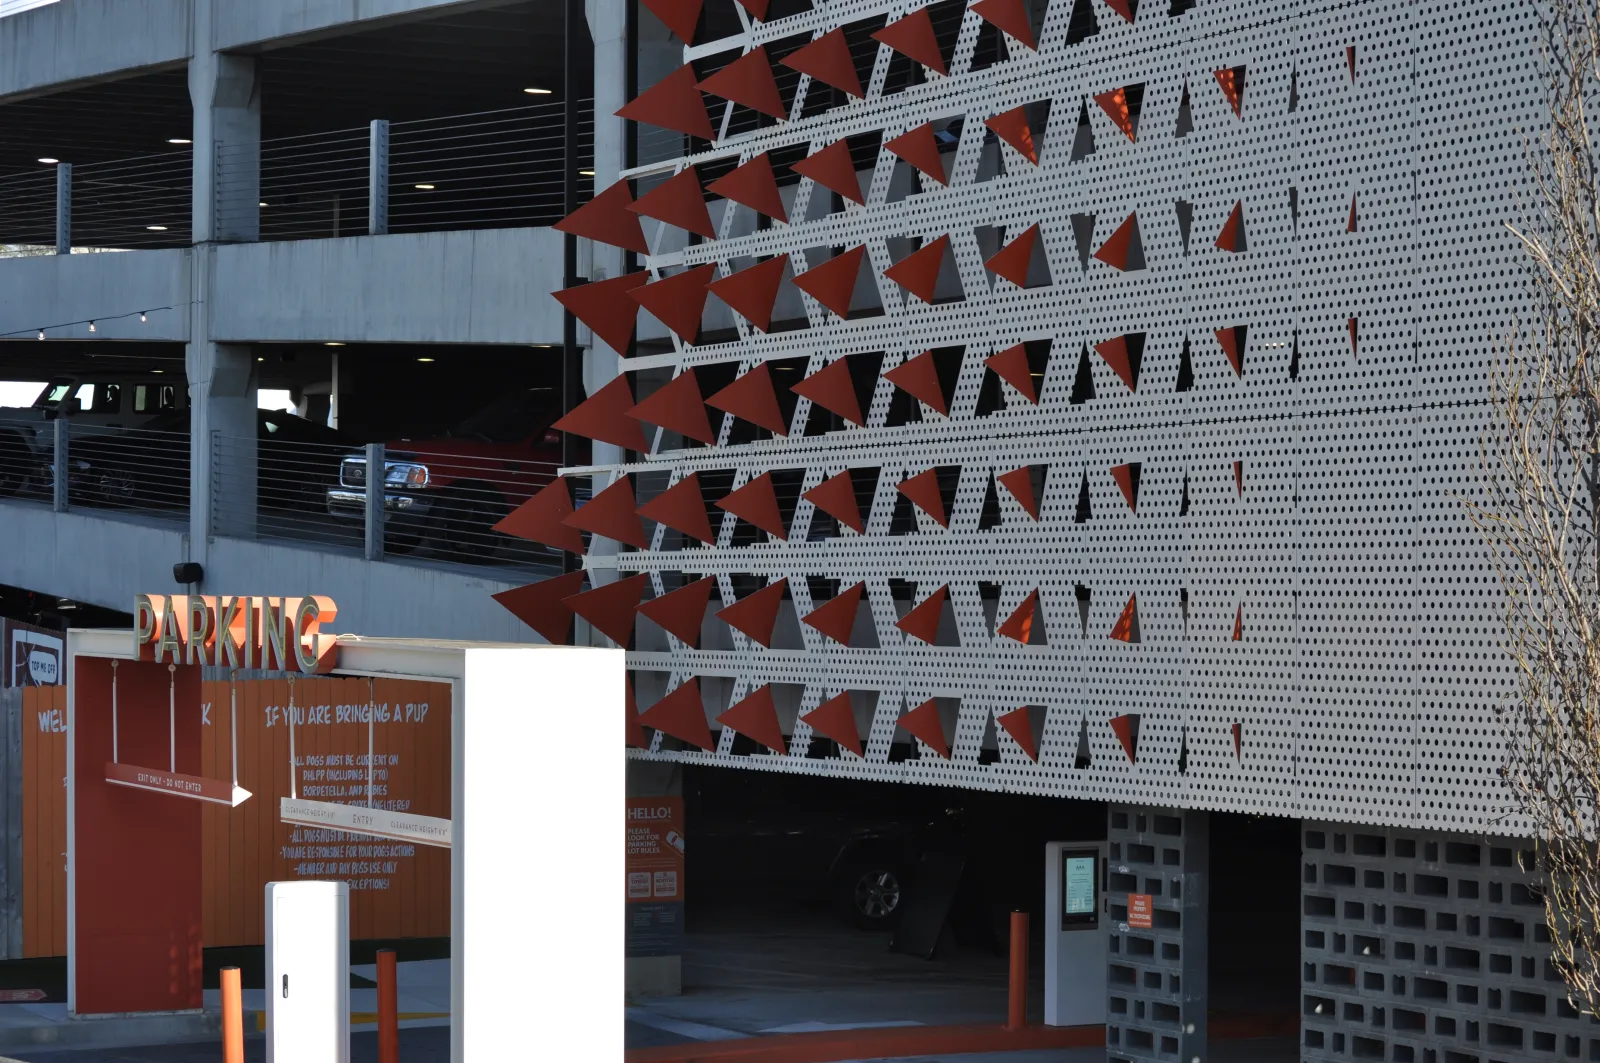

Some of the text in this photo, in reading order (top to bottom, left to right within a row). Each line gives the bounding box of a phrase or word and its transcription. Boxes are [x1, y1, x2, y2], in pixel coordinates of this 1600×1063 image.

[134, 595, 320, 674] PARKING
[31, 661, 56, 675] TOP ME OFF
[38, 709, 67, 733] WEL
[265, 706, 280, 728] IF
[308, 705, 331, 725] ARE
[336, 703, 391, 724] BRINGNG
[393, 703, 403, 723] A
[405, 702, 429, 723] PUP
[306, 756, 325, 766] DOGS
[326, 754, 344, 766] MUST
[346, 754, 354, 766] BE
[356, 754, 388, 766] CURENT
[388, 753, 399, 766] ON
[364, 768, 389, 781] LPTO)
[138, 773, 149, 782] EXIT
[150, 775, 162, 784] ONLY
[167, 779, 173, 788] DO
[174, 780, 184, 789] NOT
[185, 781, 202, 793] ENTER
[348, 785, 363, 796] AND
[364, 784, 388, 796] RBIES
[628, 806, 672, 820] HELLO!
[353, 814, 374, 826] ENTRY
[390, 820, 418, 832] CLEARANCE
[420, 825, 438, 836] HEIGHT
[628, 827, 651, 835] PLEASE
[628, 833, 660, 842] LOOK FOR
[628, 840, 657, 848] PARKING
[307, 846, 344, 859] RESPONSIBLE
[346, 845, 358, 858] FOR
[358, 845, 373, 858] YOUR
[390, 844, 415, 857] ACTIONS
[628, 846, 660, 855] LOT RULES
[382, 861, 398, 874] ONLY
